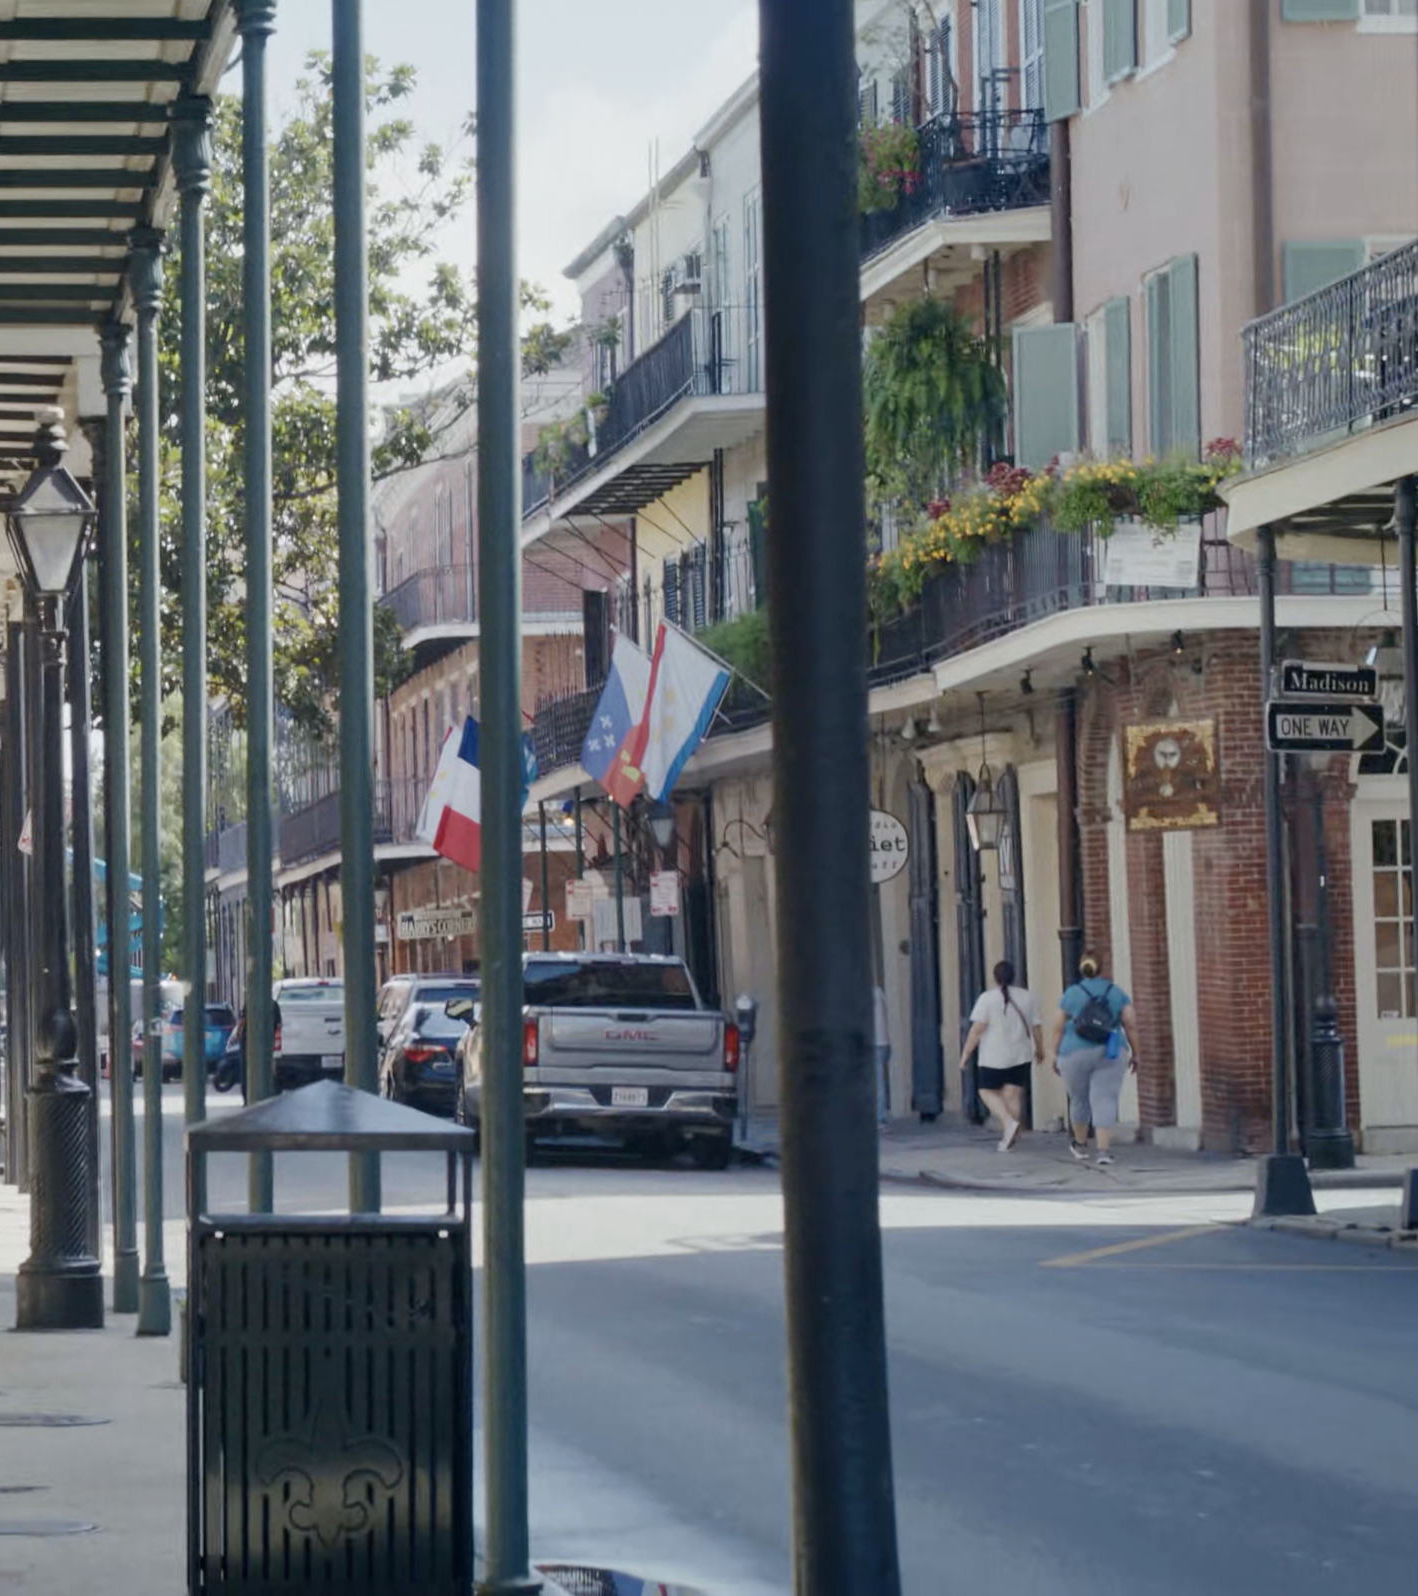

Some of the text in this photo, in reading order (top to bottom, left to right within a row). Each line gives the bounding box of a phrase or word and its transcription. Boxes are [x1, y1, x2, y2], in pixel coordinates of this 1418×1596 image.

[1290, 671, 1370, 692] Madison
[1281, 717, 1349, 737] ONE WAY
[869, 835, 906, 852] iet
[605, 1027, 660, 1041] GMC
